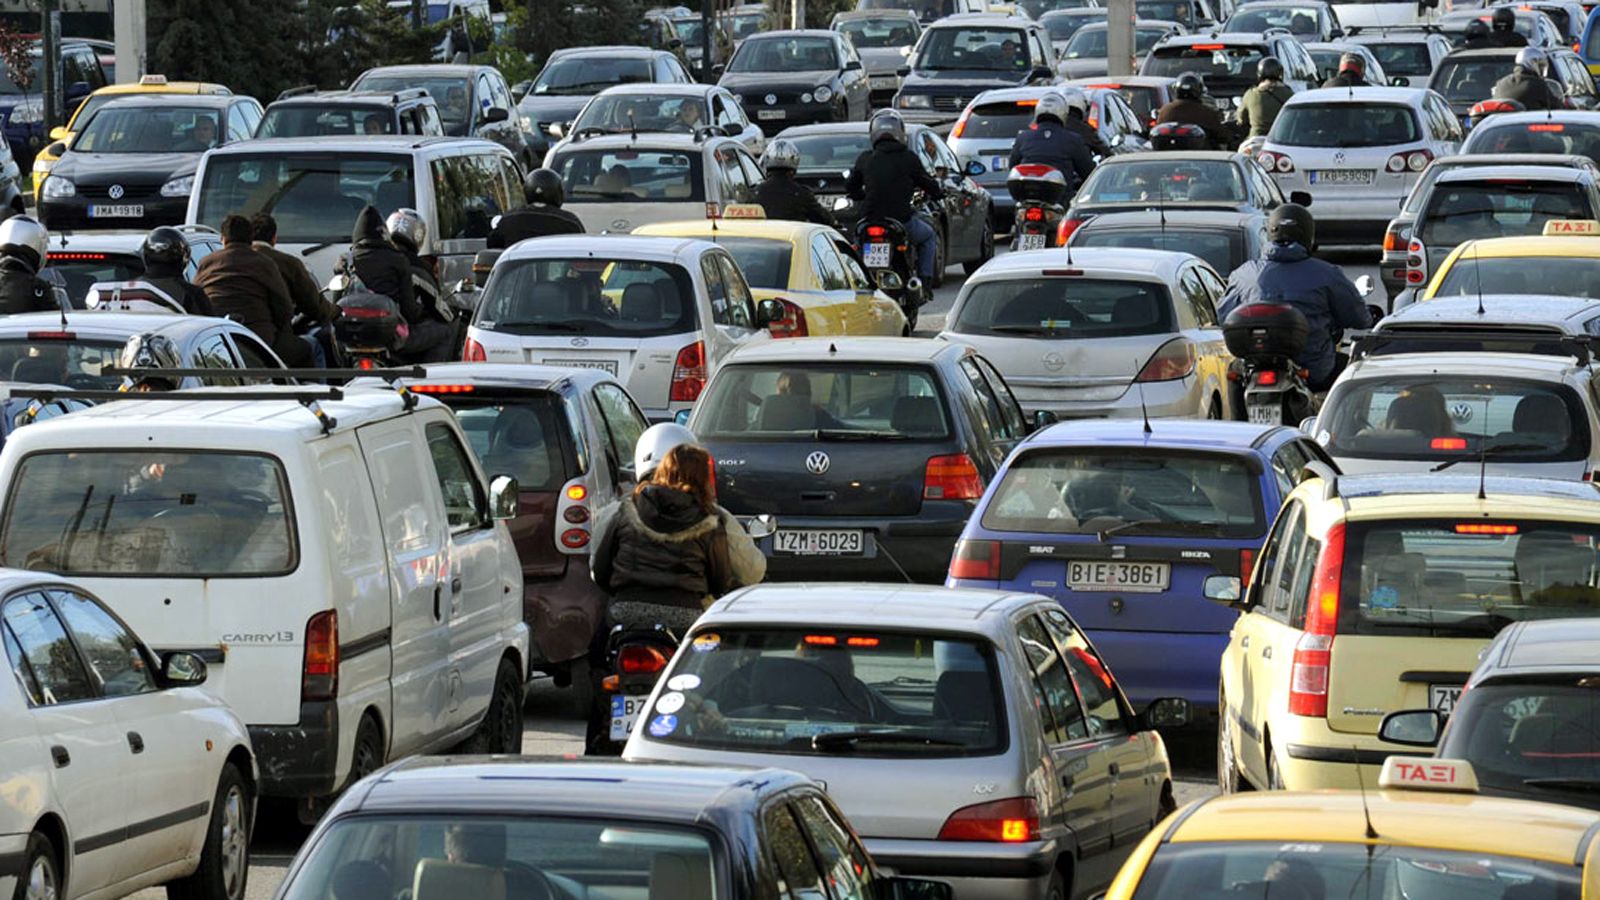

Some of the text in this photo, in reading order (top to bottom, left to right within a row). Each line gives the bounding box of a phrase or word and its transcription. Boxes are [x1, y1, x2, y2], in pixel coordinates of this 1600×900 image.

[1181, 550, 1211, 558] IBIZA
[222, 634, 274, 642] CARRY
[1395, 763, 1455, 783] ΤΑΞΙ
